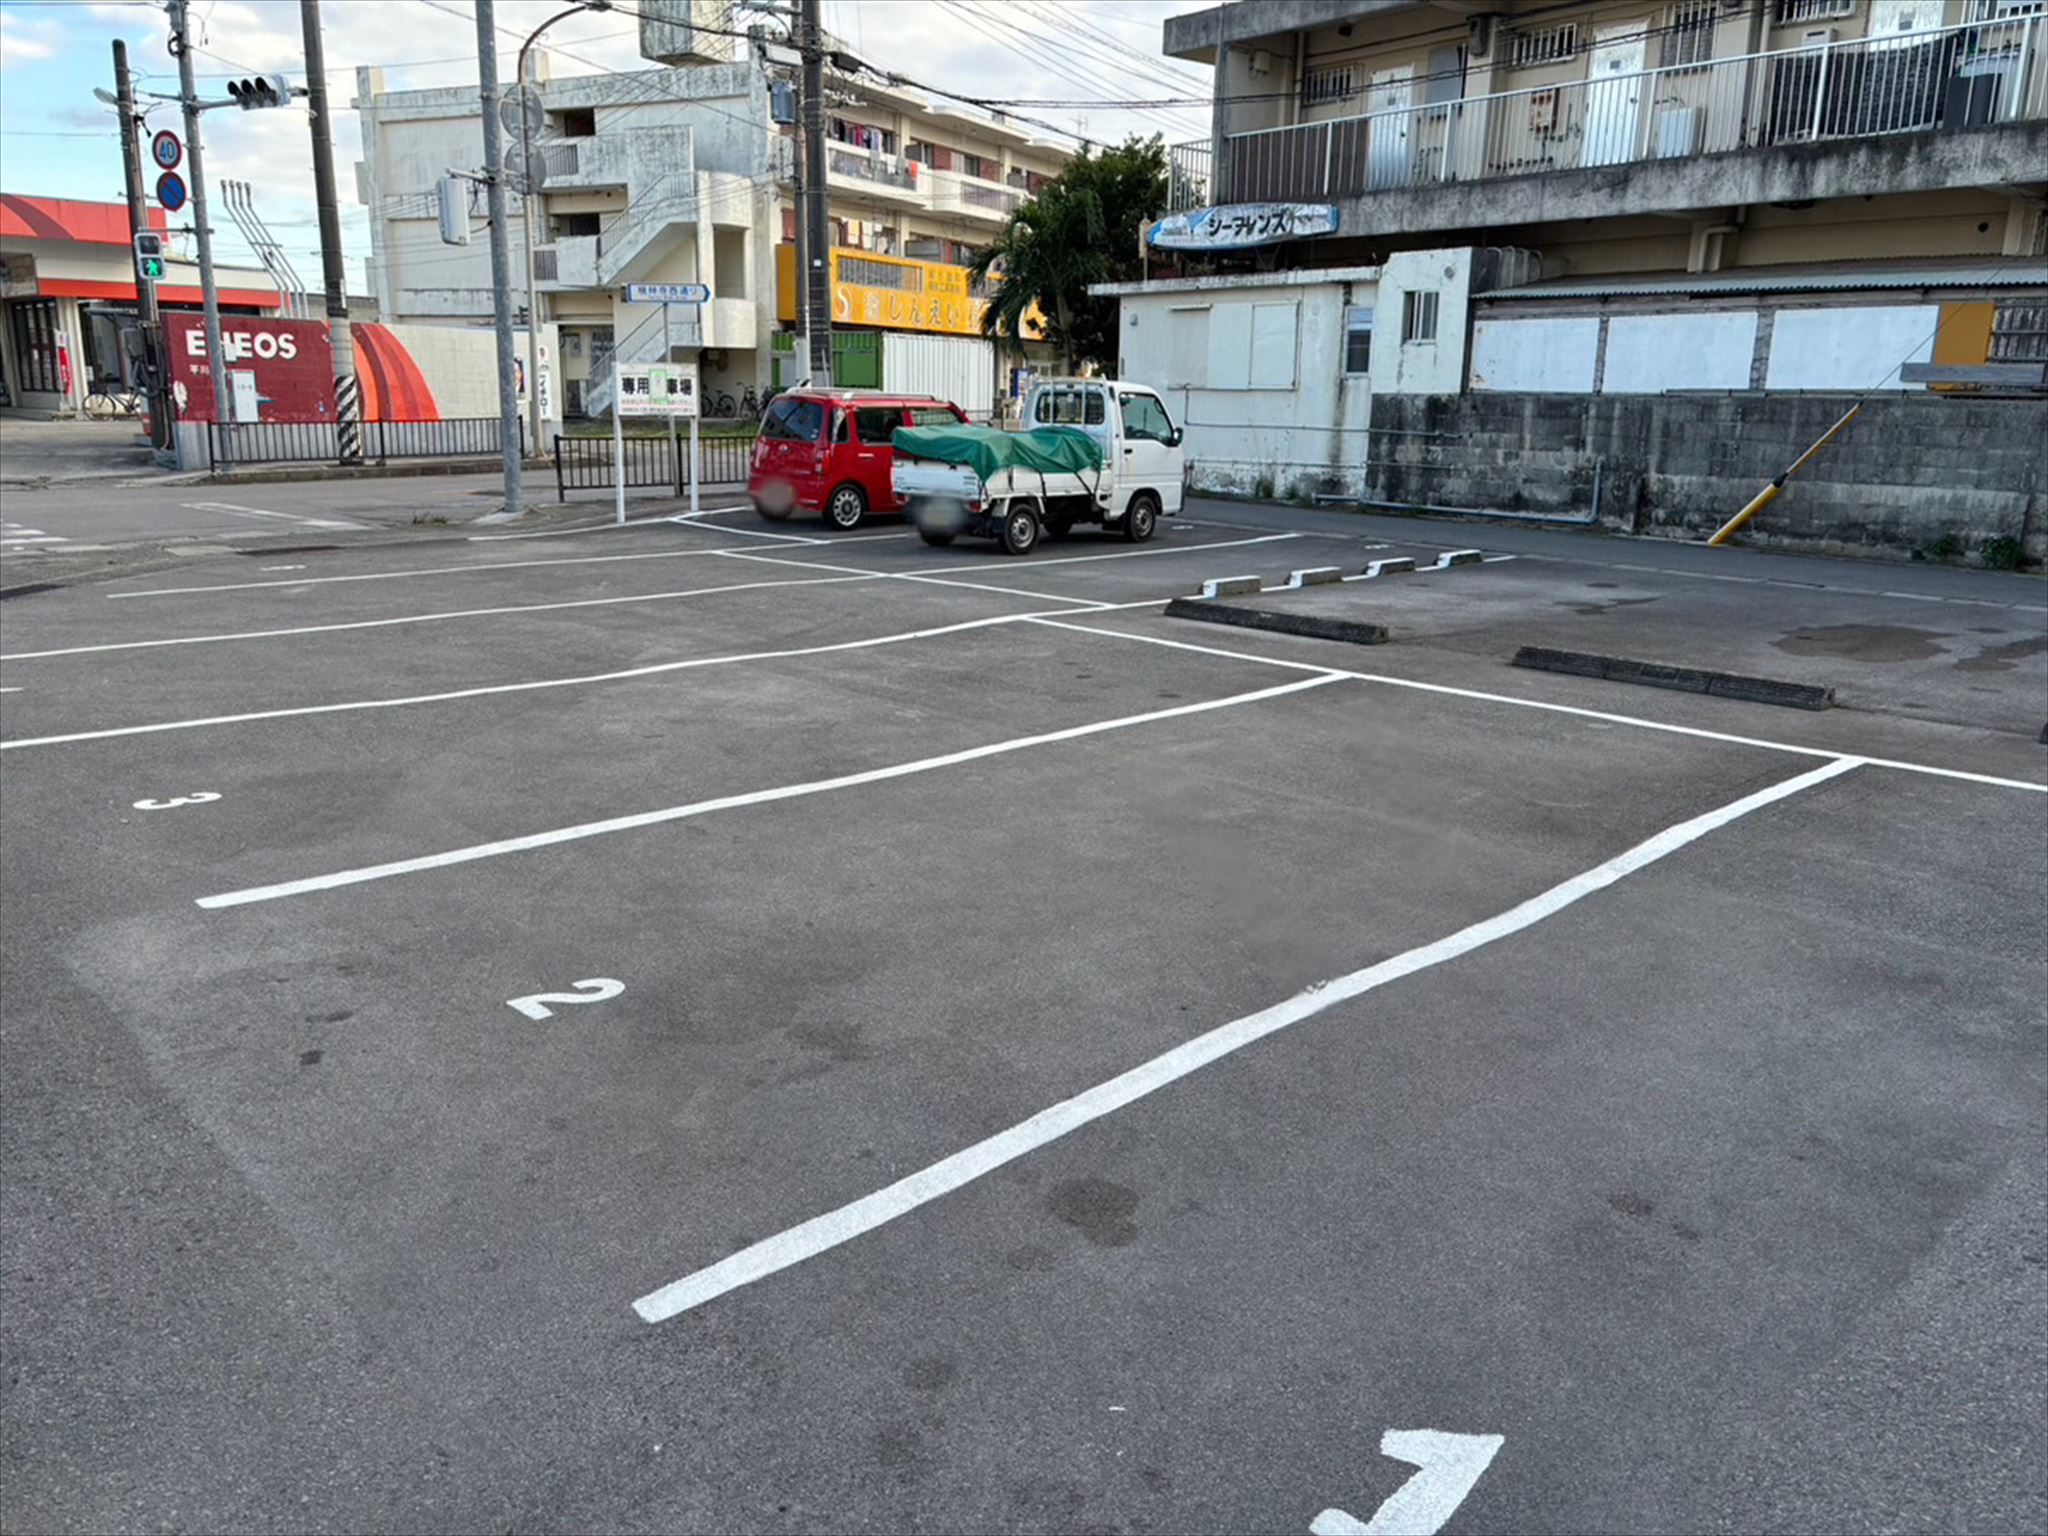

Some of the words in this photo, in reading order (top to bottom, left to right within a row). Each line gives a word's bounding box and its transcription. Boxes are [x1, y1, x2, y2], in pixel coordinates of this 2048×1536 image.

[159, 140, 176, 159] 40
[185, 329, 297, 360] EEOS
[621, 375, 693, 396] 専用車場
[132, 791, 223, 810] 3
[506, 977, 626, 1021] 2
